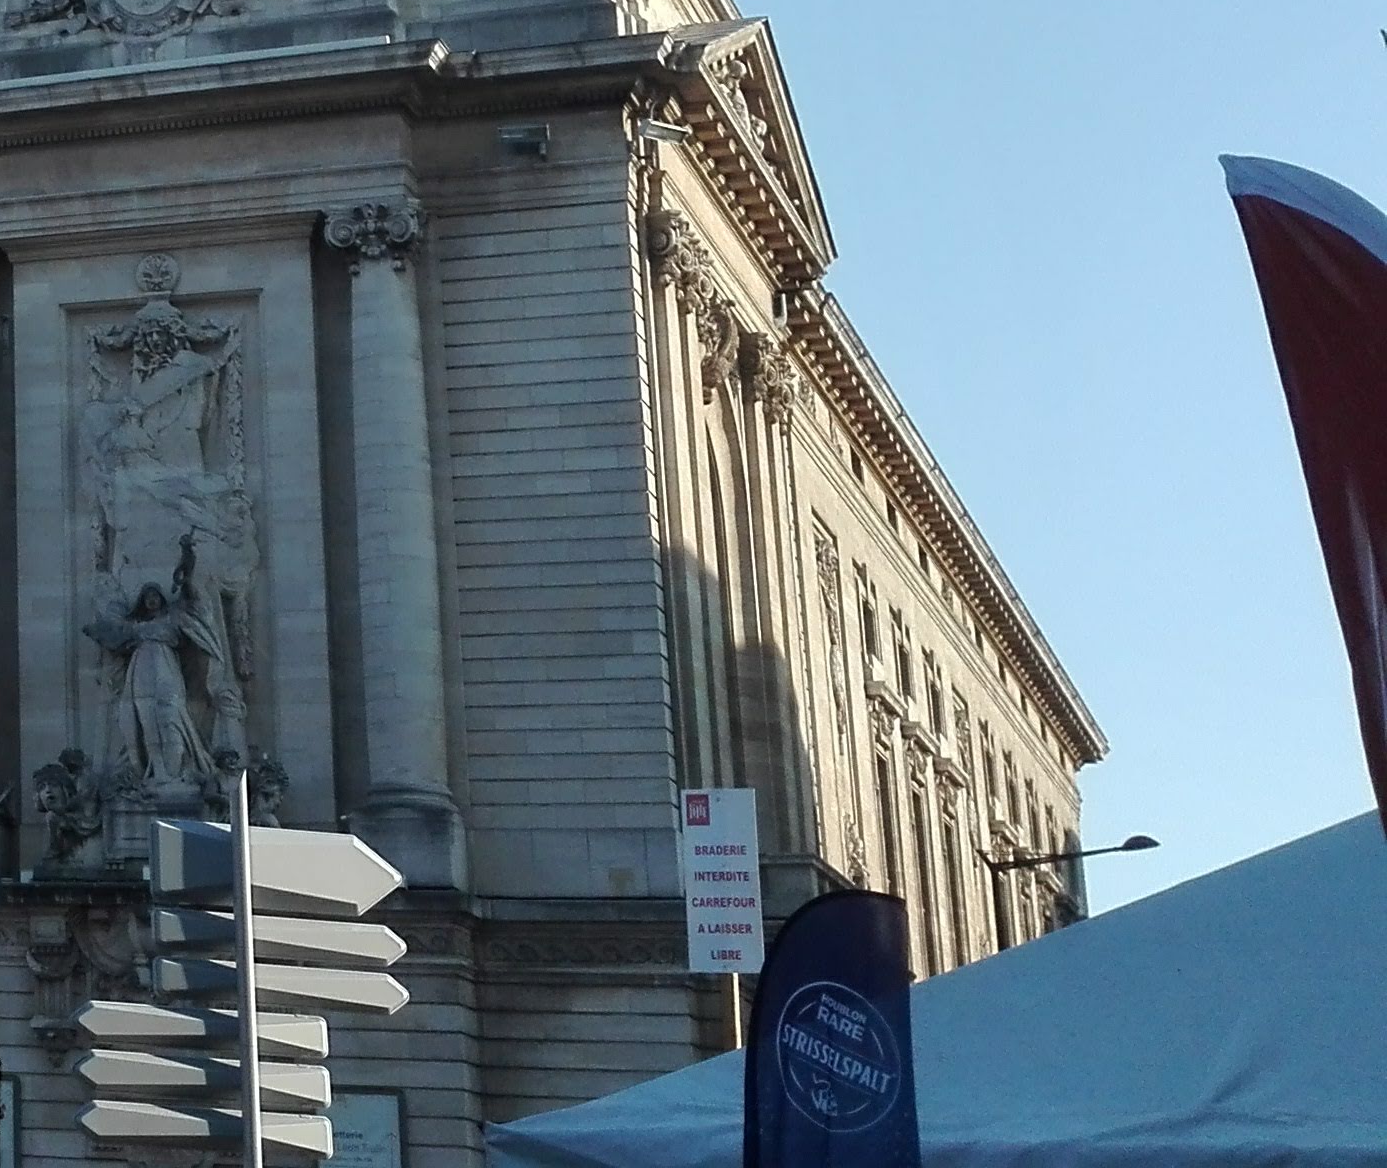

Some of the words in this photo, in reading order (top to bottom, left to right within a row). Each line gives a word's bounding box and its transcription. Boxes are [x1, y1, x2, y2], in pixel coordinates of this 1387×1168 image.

[694, 845, 747, 856] BRADERIE
[694, 871, 750, 882] INTERDITE
[691, 897, 755, 908] CARREFOUR
[697, 923, 705, 934] A
[707, 923, 752, 934] LAISSER
[711, 949, 742, 961] LIBRE
[821, 993, 868, 1024] HOUBLON
[816, 1005, 865, 1041] RARE
[782, 1023, 891, 1094] STRISSELSPALT
